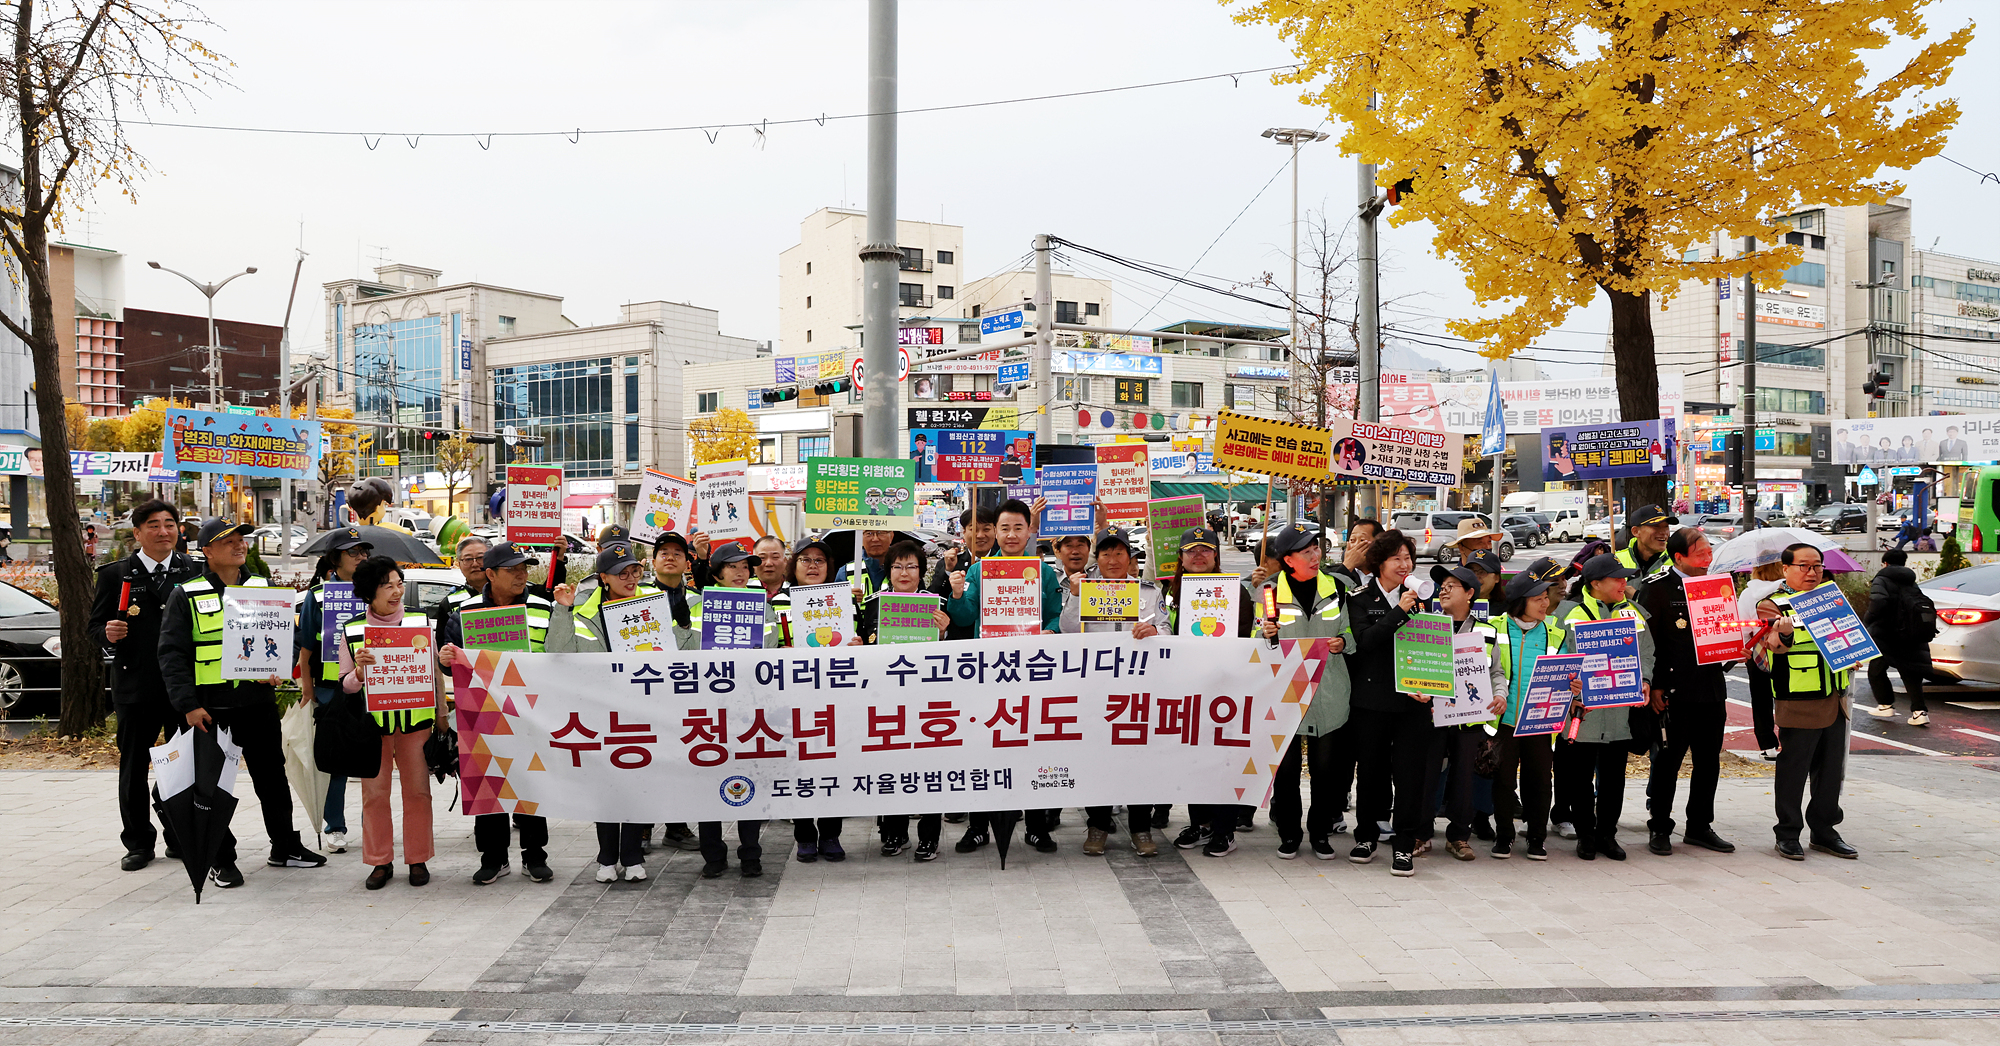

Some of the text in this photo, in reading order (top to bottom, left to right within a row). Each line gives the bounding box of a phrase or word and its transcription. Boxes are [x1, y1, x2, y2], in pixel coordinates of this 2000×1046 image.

[1766, 302, 1780, 315] 유도
[1797, 306, 1811, 319] 유도
[1002, 366, 1019, 376] 도봉로
[949, 433, 997, 441] 범죄신고 경찰청
[1352, 423, 1445, 449] 보이스피싱 예방
[1577, 428, 1640, 441] 성범죄 신고(스토킹)
[183, 430, 306, 453] 범죄 및 화재예방으로
[960, 441, 987, 453] 112
[1226, 428, 1327, 456] 사고에는 연습 없고,
[1578, 441, 1597, 451] 없이도
[1610, 440, 1629, 449] 신고가
[1630, 438, 1649, 447] 가능한
[1222, 442, 1269, 461] 생명에는
[1271, 449, 1294, 465] 예비
[1296, 453, 1328, 469] 없다!!
[1378, 443, 1449, 460] 정부 기관 사칭 수법
[112, 455, 149, 473] 가자!
[178, 447, 310, 469] 소중한 가족 지키자!!
[1151, 457, 1186, 470] 화이팅!
[1377, 453, 1448, 470] 자녀 가족 납치 수법
[1570, 449, 1650, 467] '똑똑' 캠페인
[817, 464, 905, 478] 무단횡단 위험해요
[959, 468, 986, 481] 119
[1043, 470, 1077, 478] 수험생에게
[1111, 468, 1135, 477] 힘내라!!
[1363, 464, 1455, 484] 잊지 말고, 전화 끊자!!
[815, 479, 859, 495] 횡단보도
[1103, 478, 1144, 487] 도봉구 수험생
[522, 491, 548, 499] 힘내라!!
[717, 487, 745, 498] 기원합니다!
[1099, 486, 1149, 497] 합격 기원 캠페인
[512, 500, 557, 510] 도봉구 수험생
[815, 497, 859, 512] 이용해요
[1574, 496, 1584, 505] CU
[508, 510, 561, 520] 합격 기원 캠페인
[1151, 504, 1203, 517] 수험생여러분
[842, 518, 888, 527] 서울도봉경찰서
[1152, 516, 1204, 531] 수고했다능!!
[324, 590, 353, 599] 수험생
[997, 585, 1025, 595] 힘내라!!
[324, 602, 353, 611] 희망찬
[703, 599, 764, 612] 수험생 여러분
[987, 596, 1035, 606] 도봉구 수험생
[1099, 597, 1132, 607] 1,2,3,4,5
[1190, 599, 1229, 611] 행복시작
[1794, 594, 1825, 610] 수험생에게
[881, 602, 937, 614] 수험생여러분
[982, 606, 1039, 617] 합격 기원 캠페인
[1098, 607, 1123, 616] 기동대
[1702, 603, 1725, 615] 힘내라!!
[703, 612, 764, 624] 희망찬 미래를
[802, 607, 842, 622] 행복시작
[251, 620, 290, 631] 기원합니다!
[464, 613, 525, 630] 수험생여러분
[1406, 619, 1451, 632] 험생여러분
[1697, 616, 1715, 626] 도봉구
[619, 619, 661, 639] 행복시작
[714, 625, 752, 645] 응원
[1576, 627, 1636, 639] 수험생에게 전하는
[1694, 627, 1722, 638] 합격 기원
[465, 629, 527, 646] 수고했다능!!
[1397, 631, 1452, 646] 수고했다능!!
[1577, 640, 1599, 650] 따뜻한
[382, 654, 415, 664] 힘내라!!
[372, 664, 426, 675] 도봉구 수험생
[755, 658, 870, 691] 여러분,
[1455, 664, 1486, 677] 원합니다!
[368, 675, 432, 686] 합격 기원 캠페인
[1588, 694, 1603, 702] 도봉구
[549, 693, 1254, 770] 수능 청소년 보호·선도 캠페인
[1038, 765, 1069, 775] dobong
[771, 775, 840, 799] 도봉구
[852, 768, 1013, 795] 자율방범연합대
